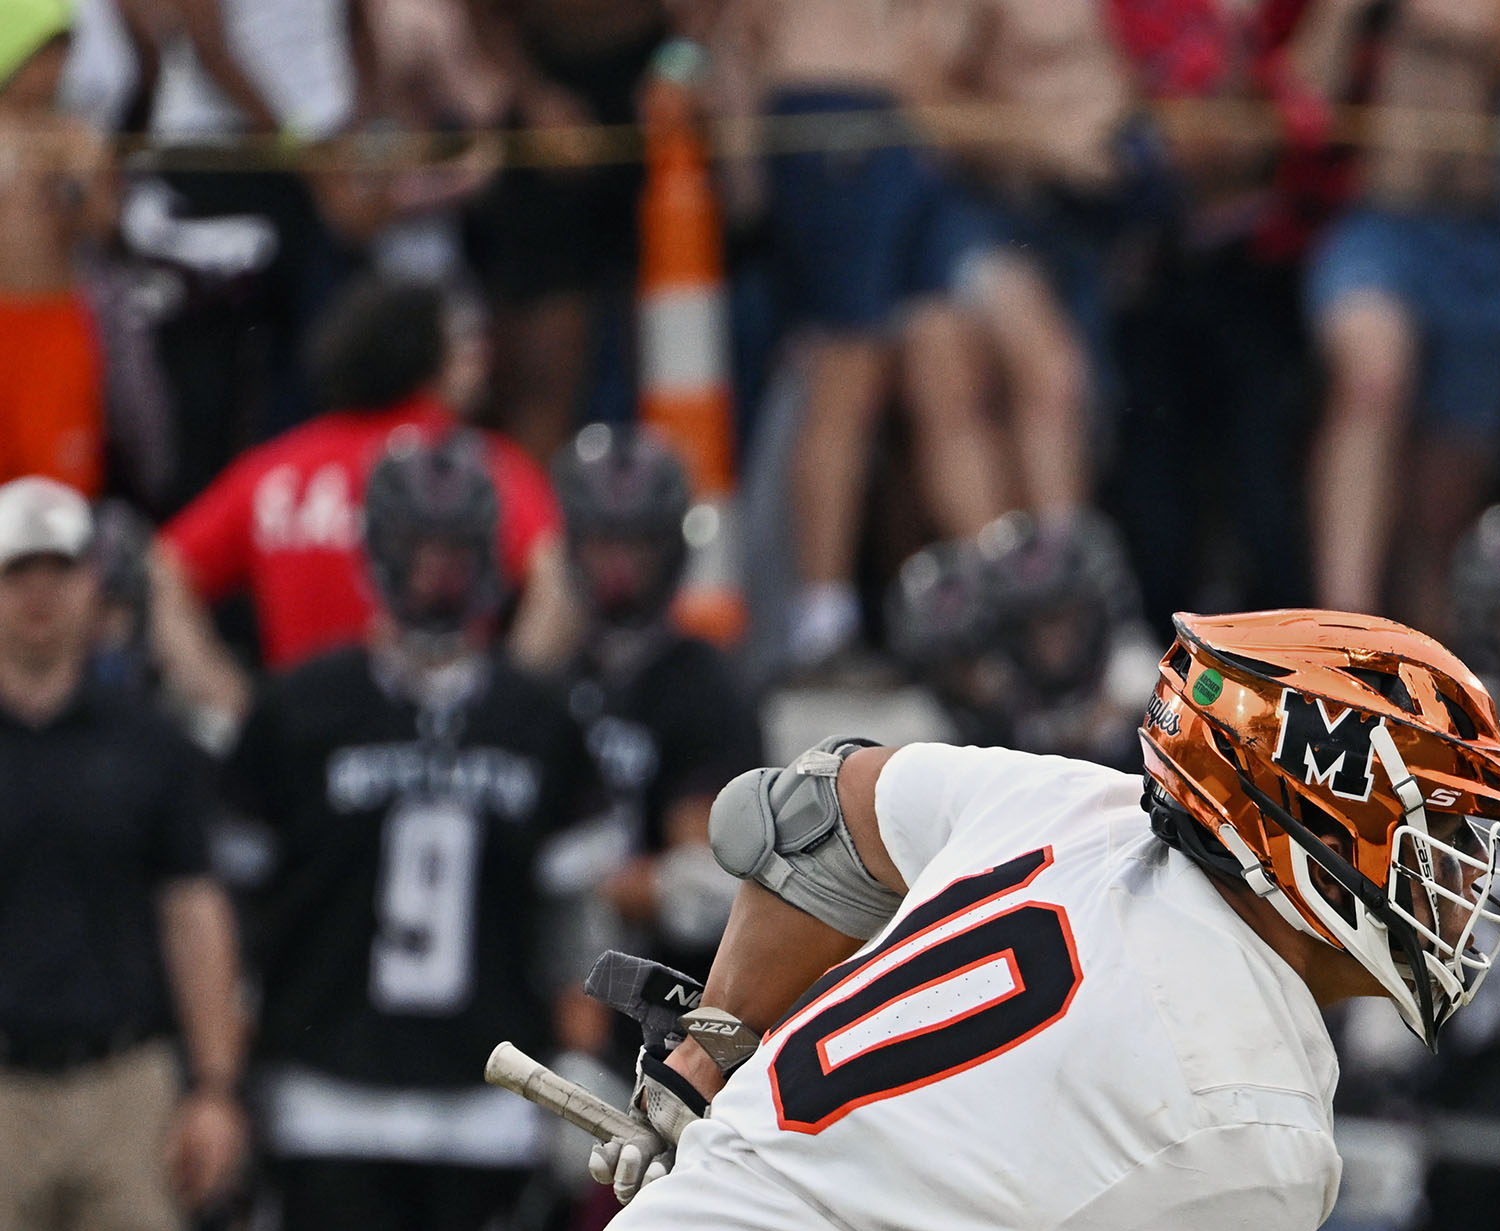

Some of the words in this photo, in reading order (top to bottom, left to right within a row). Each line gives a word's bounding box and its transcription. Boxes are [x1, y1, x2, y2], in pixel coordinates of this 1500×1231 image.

[1272, 687, 1386, 803] M
[370, 800, 484, 1013] 9
[688, 1020, 741, 1037] RZR
[763, 845, 1085, 1136] 10
